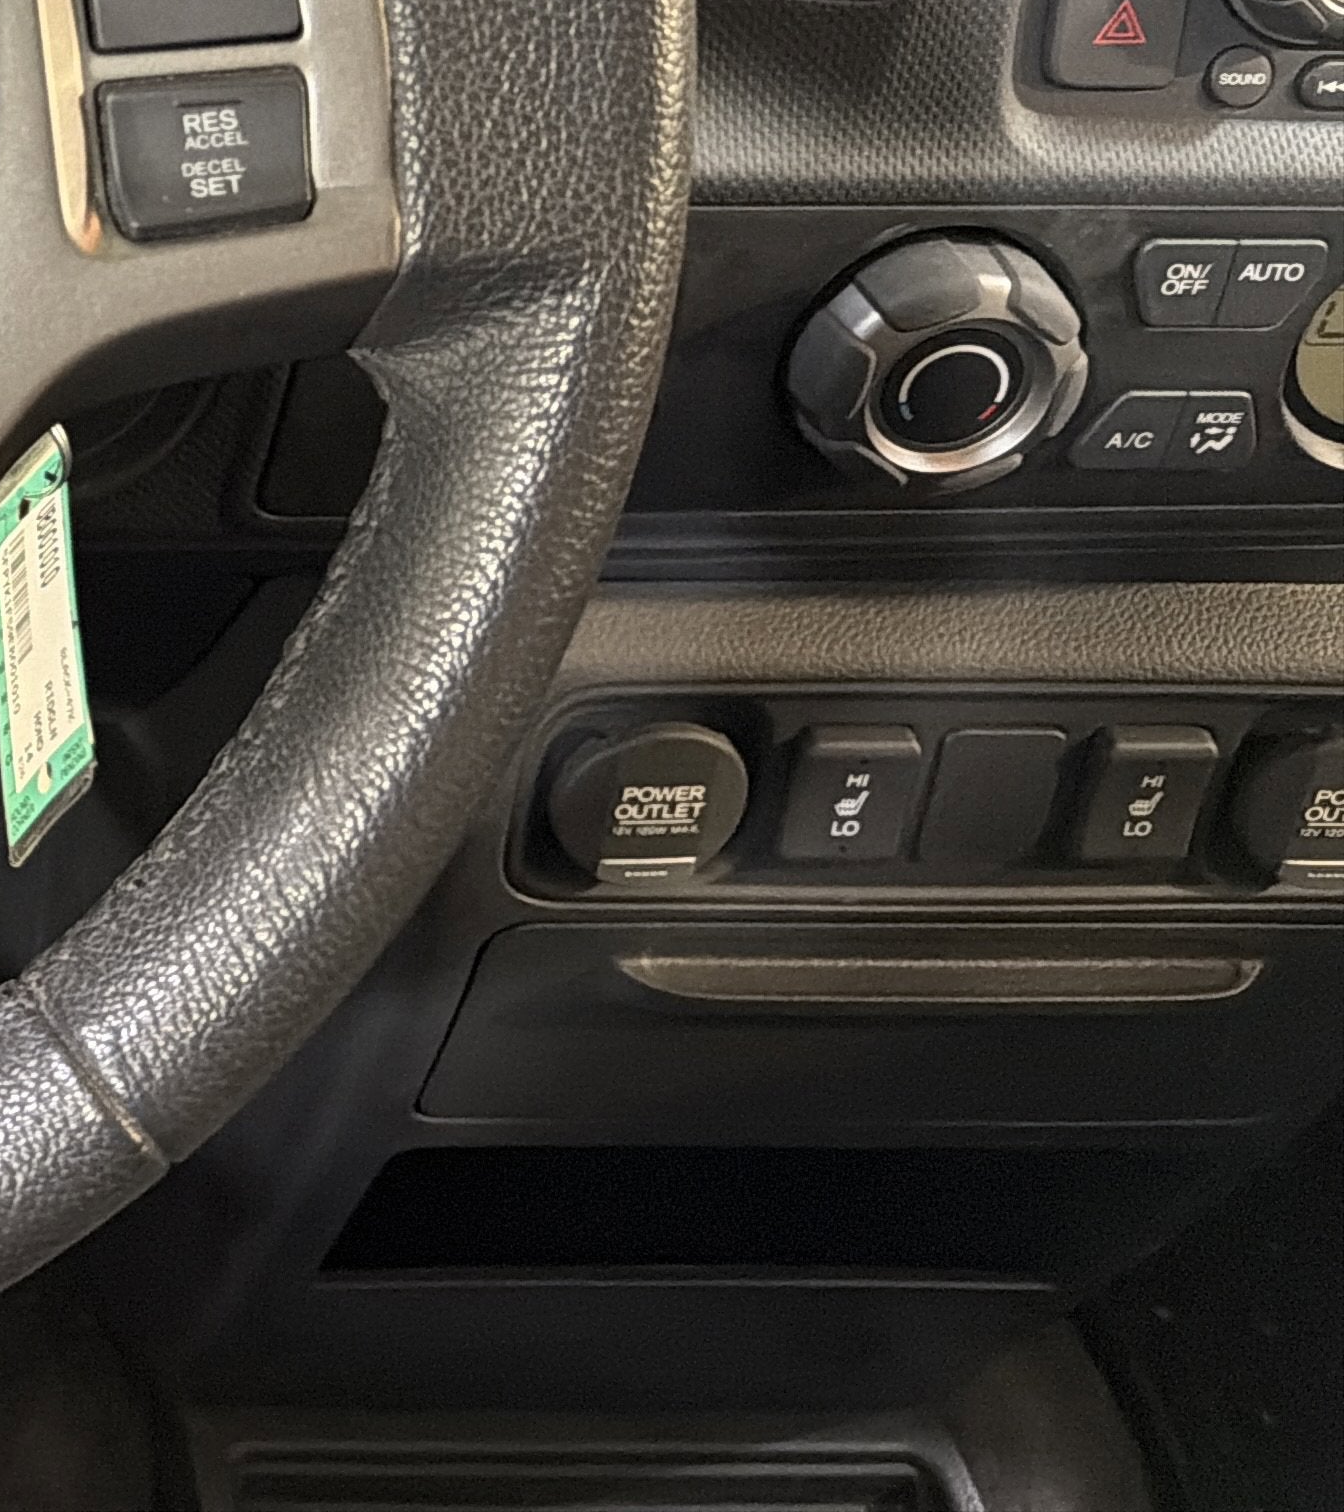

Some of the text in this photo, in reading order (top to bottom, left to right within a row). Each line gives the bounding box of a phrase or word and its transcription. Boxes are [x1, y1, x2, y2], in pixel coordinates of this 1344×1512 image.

[1218, 72, 1267, 86] SOUND
[182, 110, 239, 133] RES
[184, 133, 248, 150] ACCEL
[181, 159, 246, 177] DECEL
[190, 177, 242, 199] SET
[1166, 263, 1212, 280] ON/
[1237, 262, 1305, 282] AUTO
[1160, 279, 1209, 296] OFF
[1196, 412, 1244, 424] MODE
[1104, 431, 1154, 449] A/C
[846, 773, 870, 787] HI
[1141, 775, 1165, 788] HI
[622, 785, 706, 803] POWER
[614, 802, 706, 819] OUTLET
[830, 820, 860, 837] LO
[1123, 820, 1153, 837] LO
